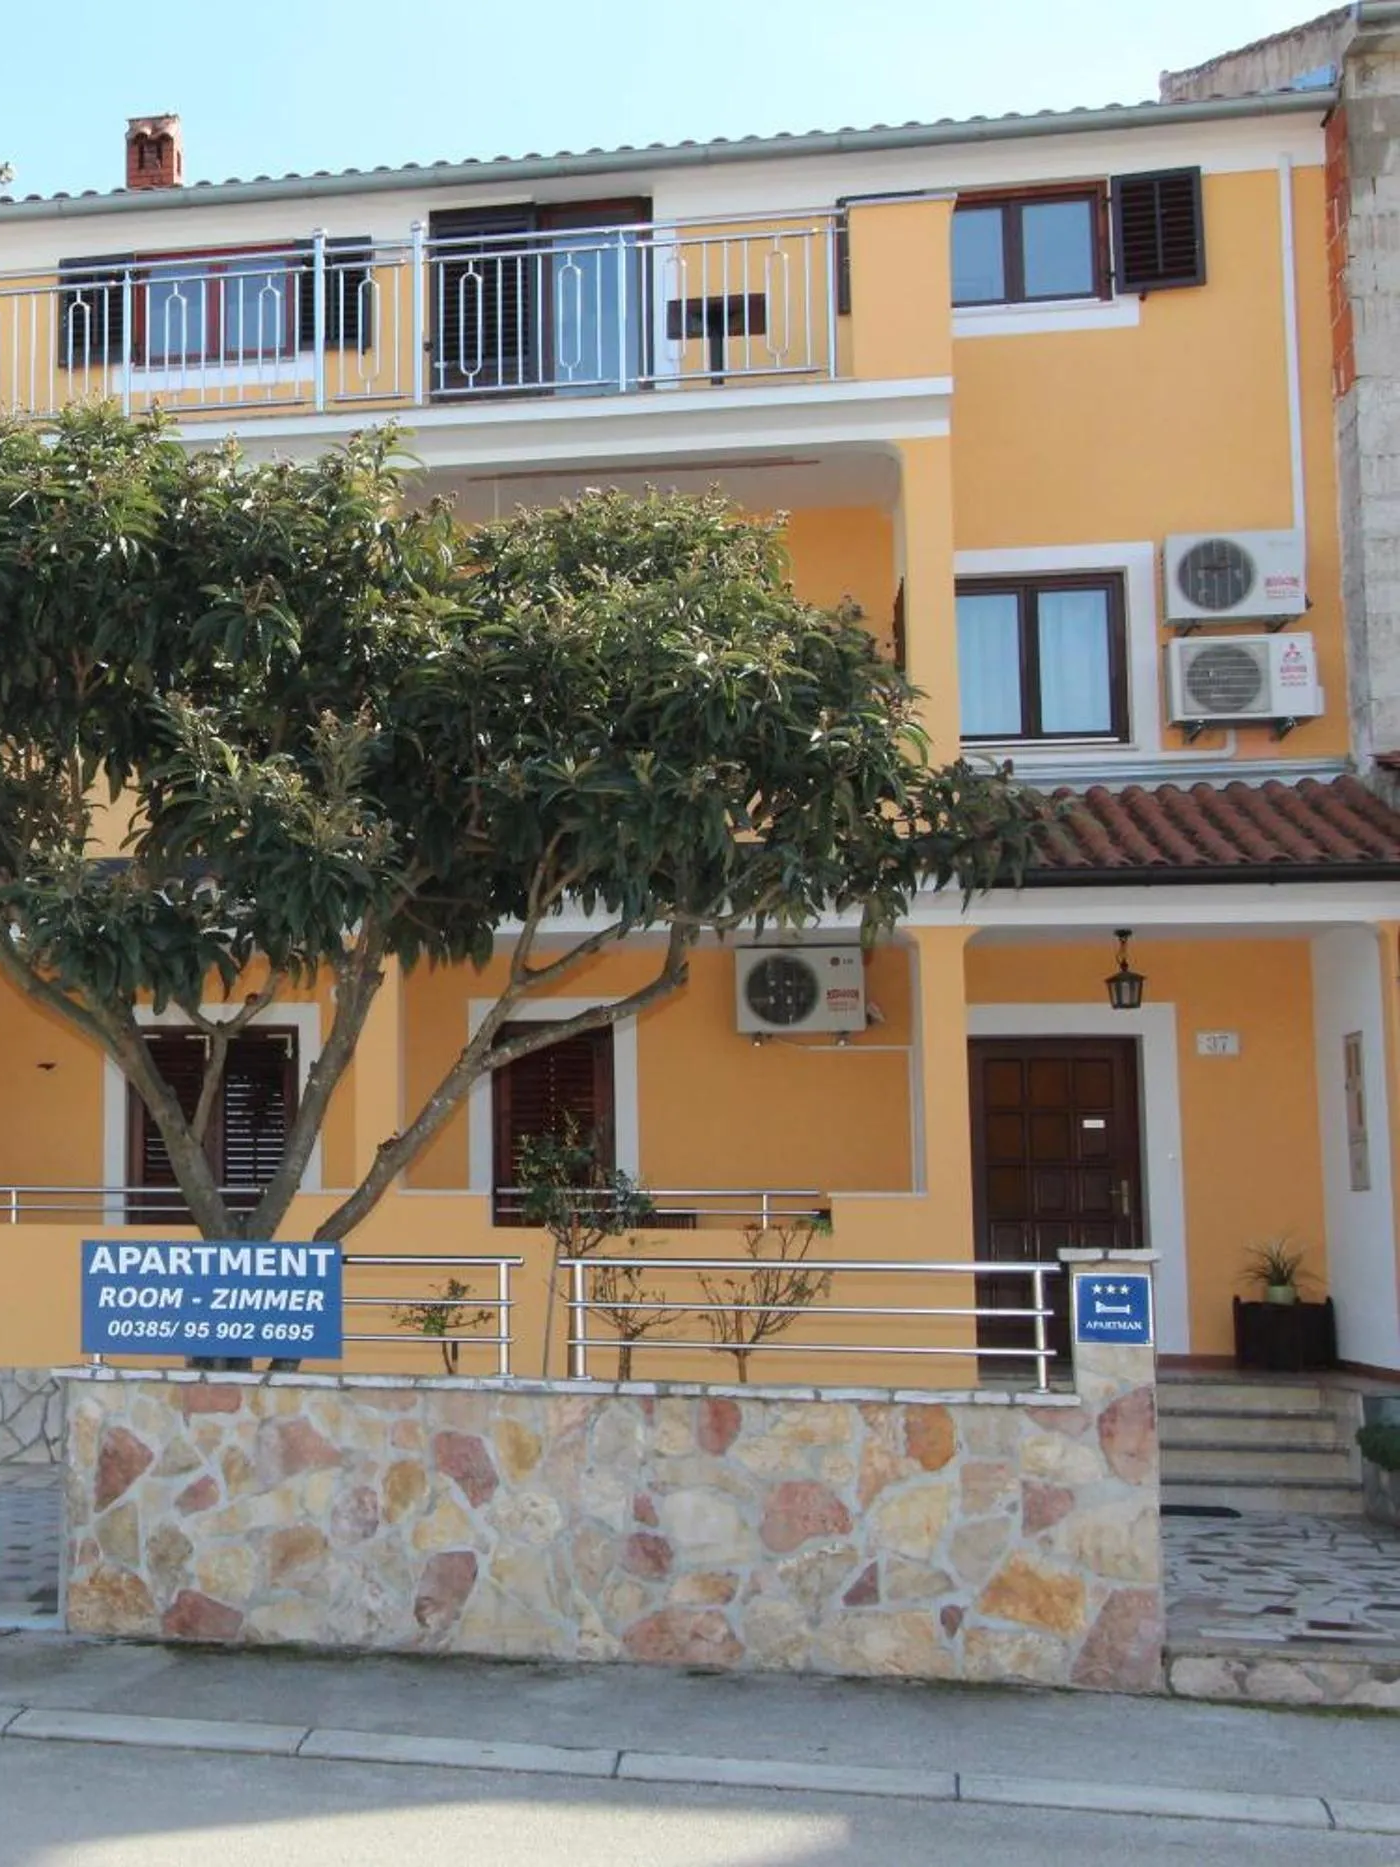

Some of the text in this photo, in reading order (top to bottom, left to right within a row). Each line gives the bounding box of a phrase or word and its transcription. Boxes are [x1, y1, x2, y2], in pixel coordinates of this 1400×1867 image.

[89, 1246, 335, 1277] APARTMENT
[99, 1287, 184, 1309] ROOM
[210, 1288, 325, 1312] ZIMMER
[107, 1320, 314, 1341] 00385/ 95 902 6695
[1085, 1320, 1143, 1331] APARTMAN
